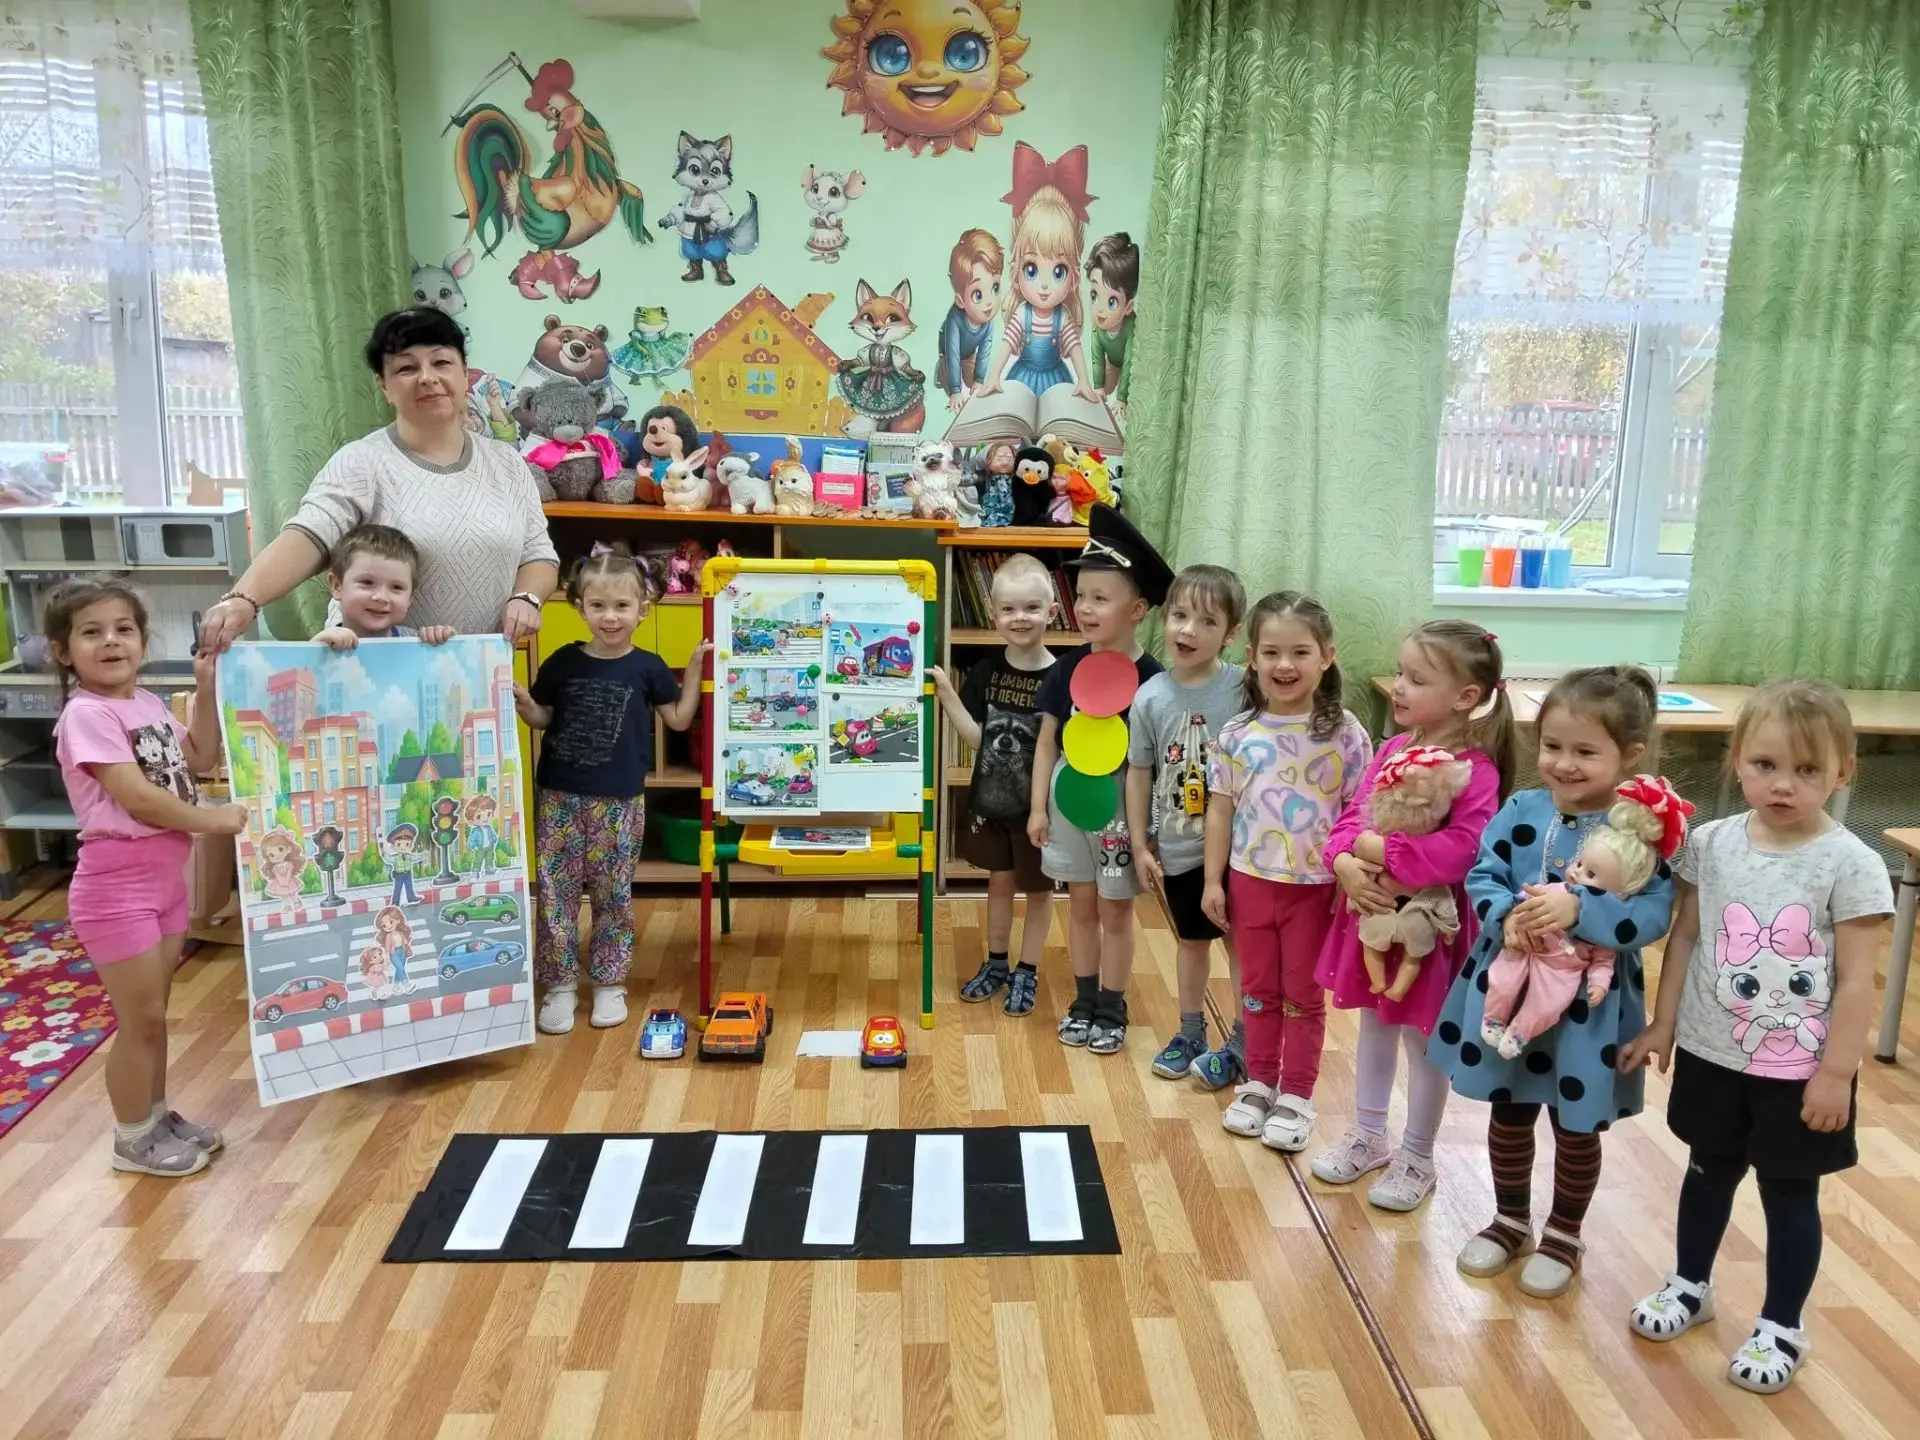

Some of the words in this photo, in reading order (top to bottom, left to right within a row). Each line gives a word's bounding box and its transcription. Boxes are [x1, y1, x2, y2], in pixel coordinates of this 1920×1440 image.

[991, 671, 999, 683] В
[1000, 673, 1043, 691] СМЫСЛ
[1189, 788, 1199, 801] 9
[1102, 867, 1122, 877] CAR
